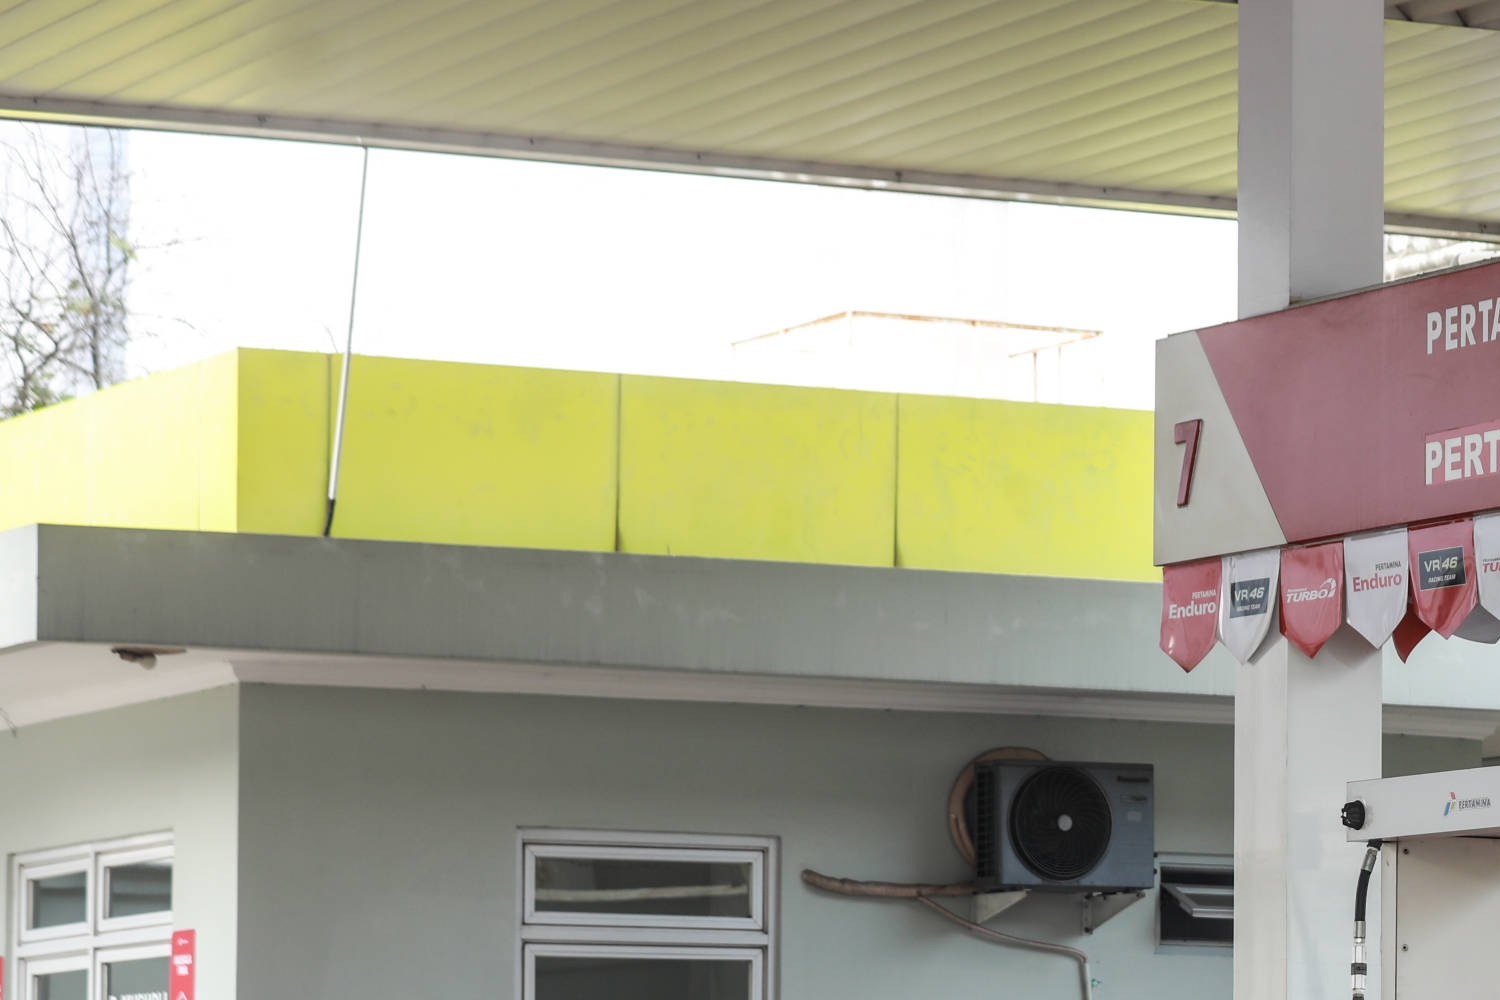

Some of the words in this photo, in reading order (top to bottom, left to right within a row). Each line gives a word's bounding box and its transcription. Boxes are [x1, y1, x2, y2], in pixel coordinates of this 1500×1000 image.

[1174, 419, 1202, 507] 7
[1375, 560, 1401, 572] PERTAMINA
[1353, 573, 1402, 592] Enduro
[1191, 589, 1216, 599] PERTAMINA
[1286, 590, 1327, 603] TURBO
[1168, 602, 1216, 619] Enduro
